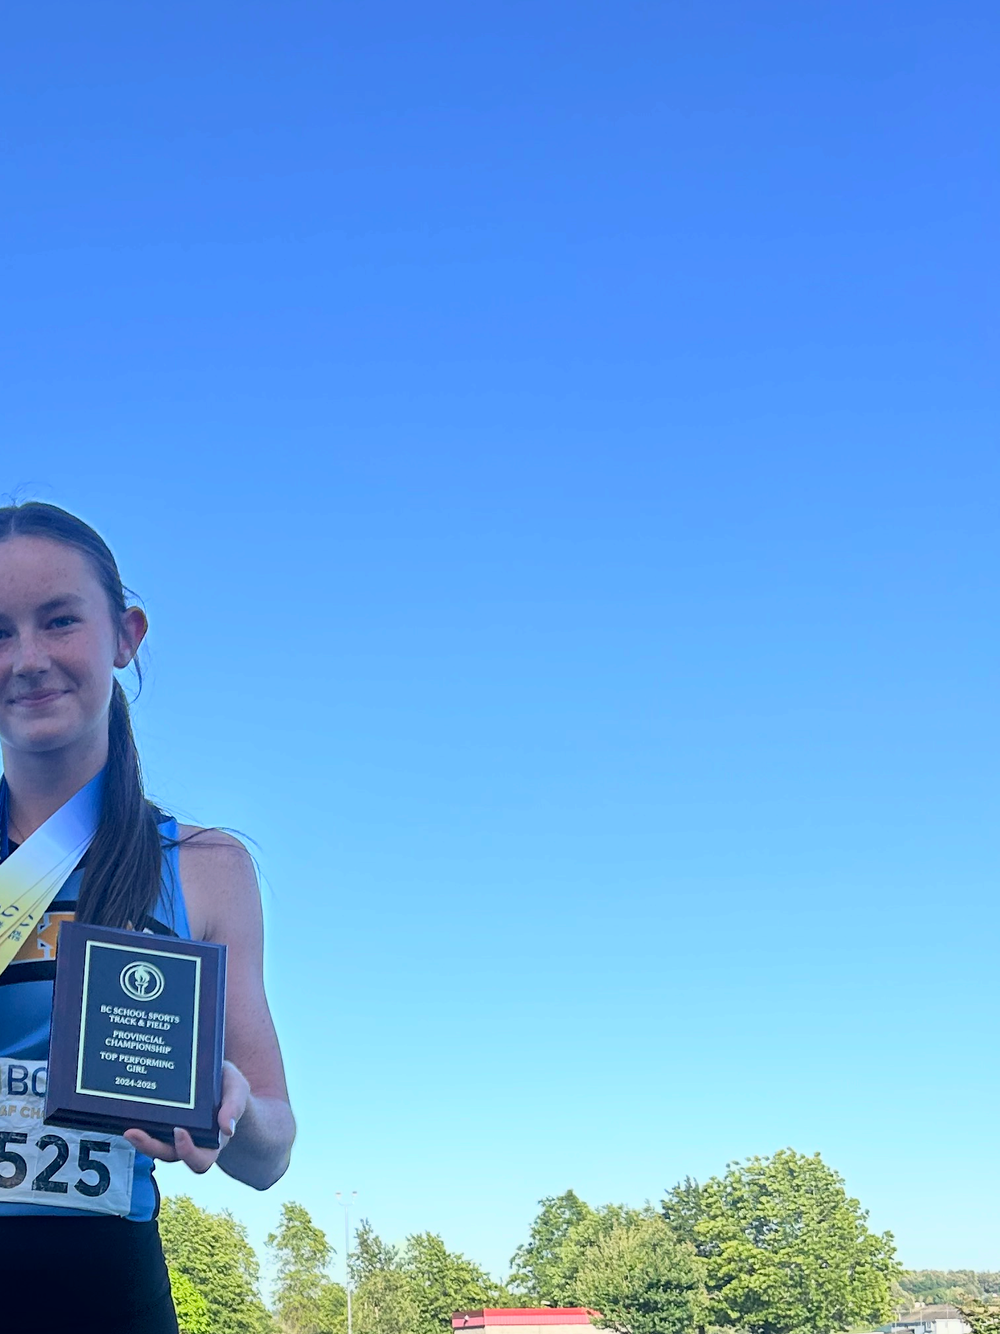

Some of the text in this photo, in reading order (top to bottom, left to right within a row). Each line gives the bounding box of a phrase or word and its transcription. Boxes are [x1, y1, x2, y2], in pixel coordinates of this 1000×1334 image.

[100, 1005, 180, 1024] BC SCHOOL SPORTS
[109, 1014, 137, 1026] TRACK
[146, 1020, 171, 1031] FIELD
[113, 1030, 165, 1045] PROVINCIAL
[105, 1038, 172, 1054] CHAMPIONSHIP
[100, 1051, 175, 1070] TOP PERFORMING
[126, 1064, 148, 1074] GIRL
[115, 1077, 157, 1090] 2024-2025
